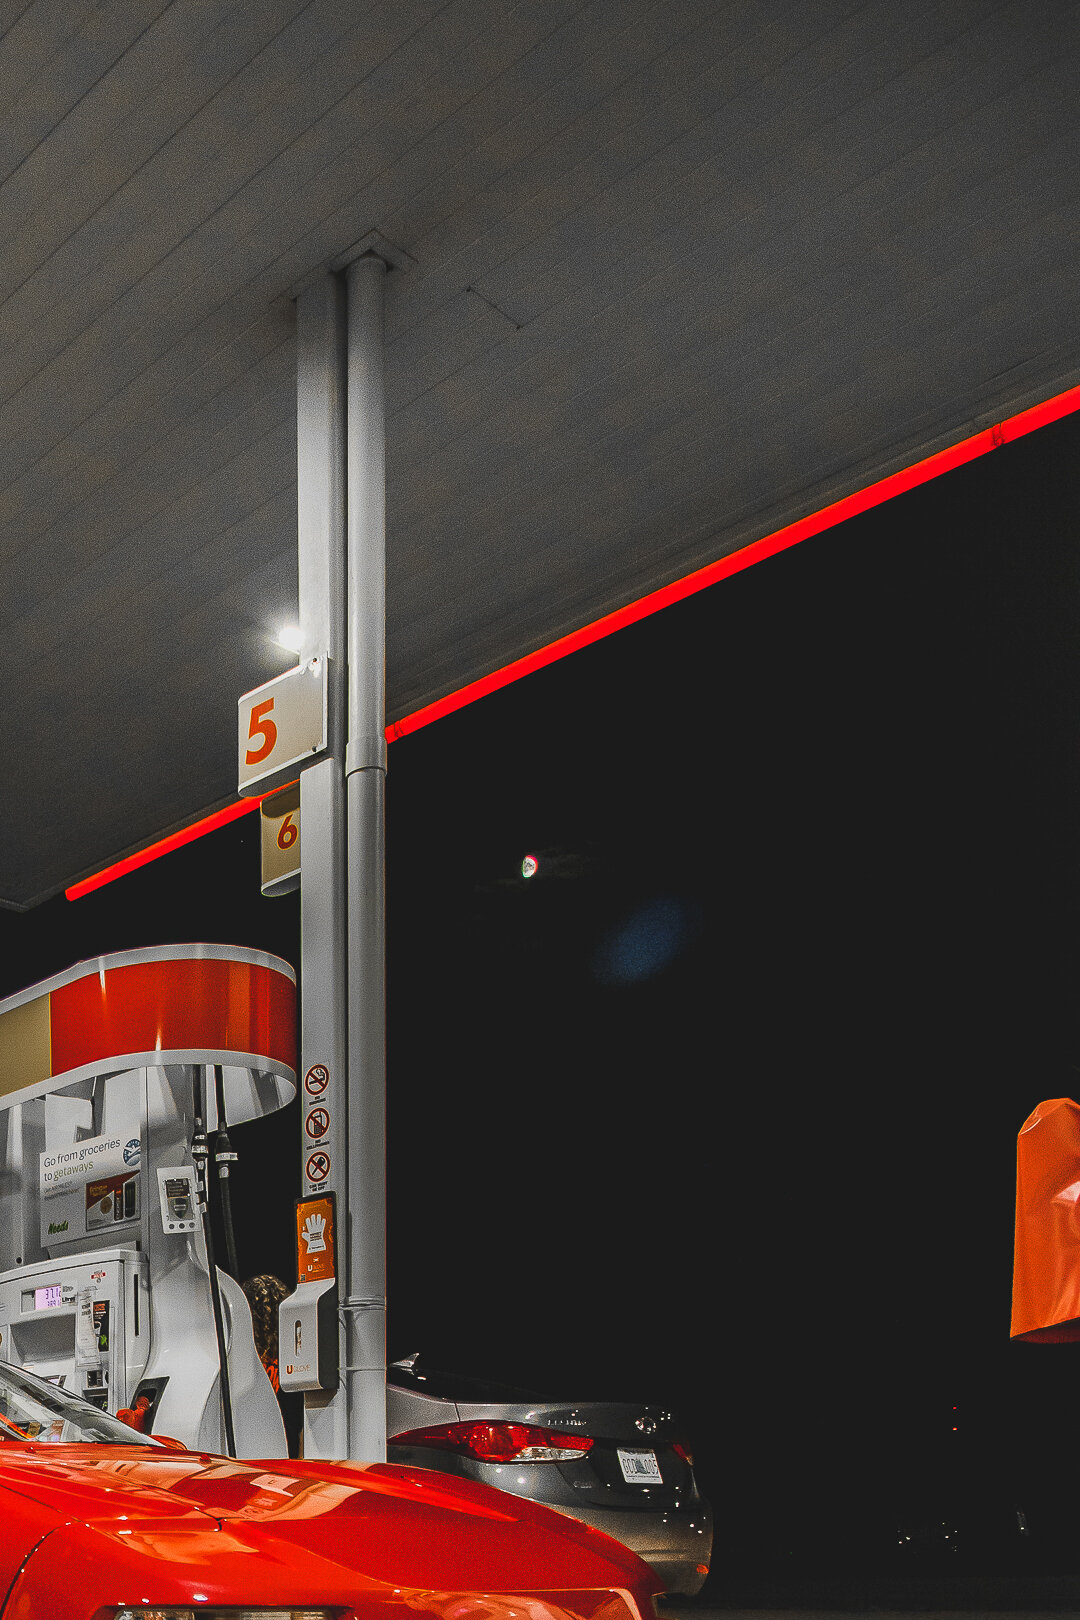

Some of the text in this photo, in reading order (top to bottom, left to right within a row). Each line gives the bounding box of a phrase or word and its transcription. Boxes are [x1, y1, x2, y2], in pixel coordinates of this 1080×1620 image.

[245, 697, 278, 766] 5
[277, 814, 298, 850] 6
[44, 1157, 56, 1167] Go
[57, 1150, 78, 1164] from
[79, 1139, 121, 1160] groceries
[44, 1161, 94, 1181] to getaways
[47, 1220, 69, 1236] Needs
